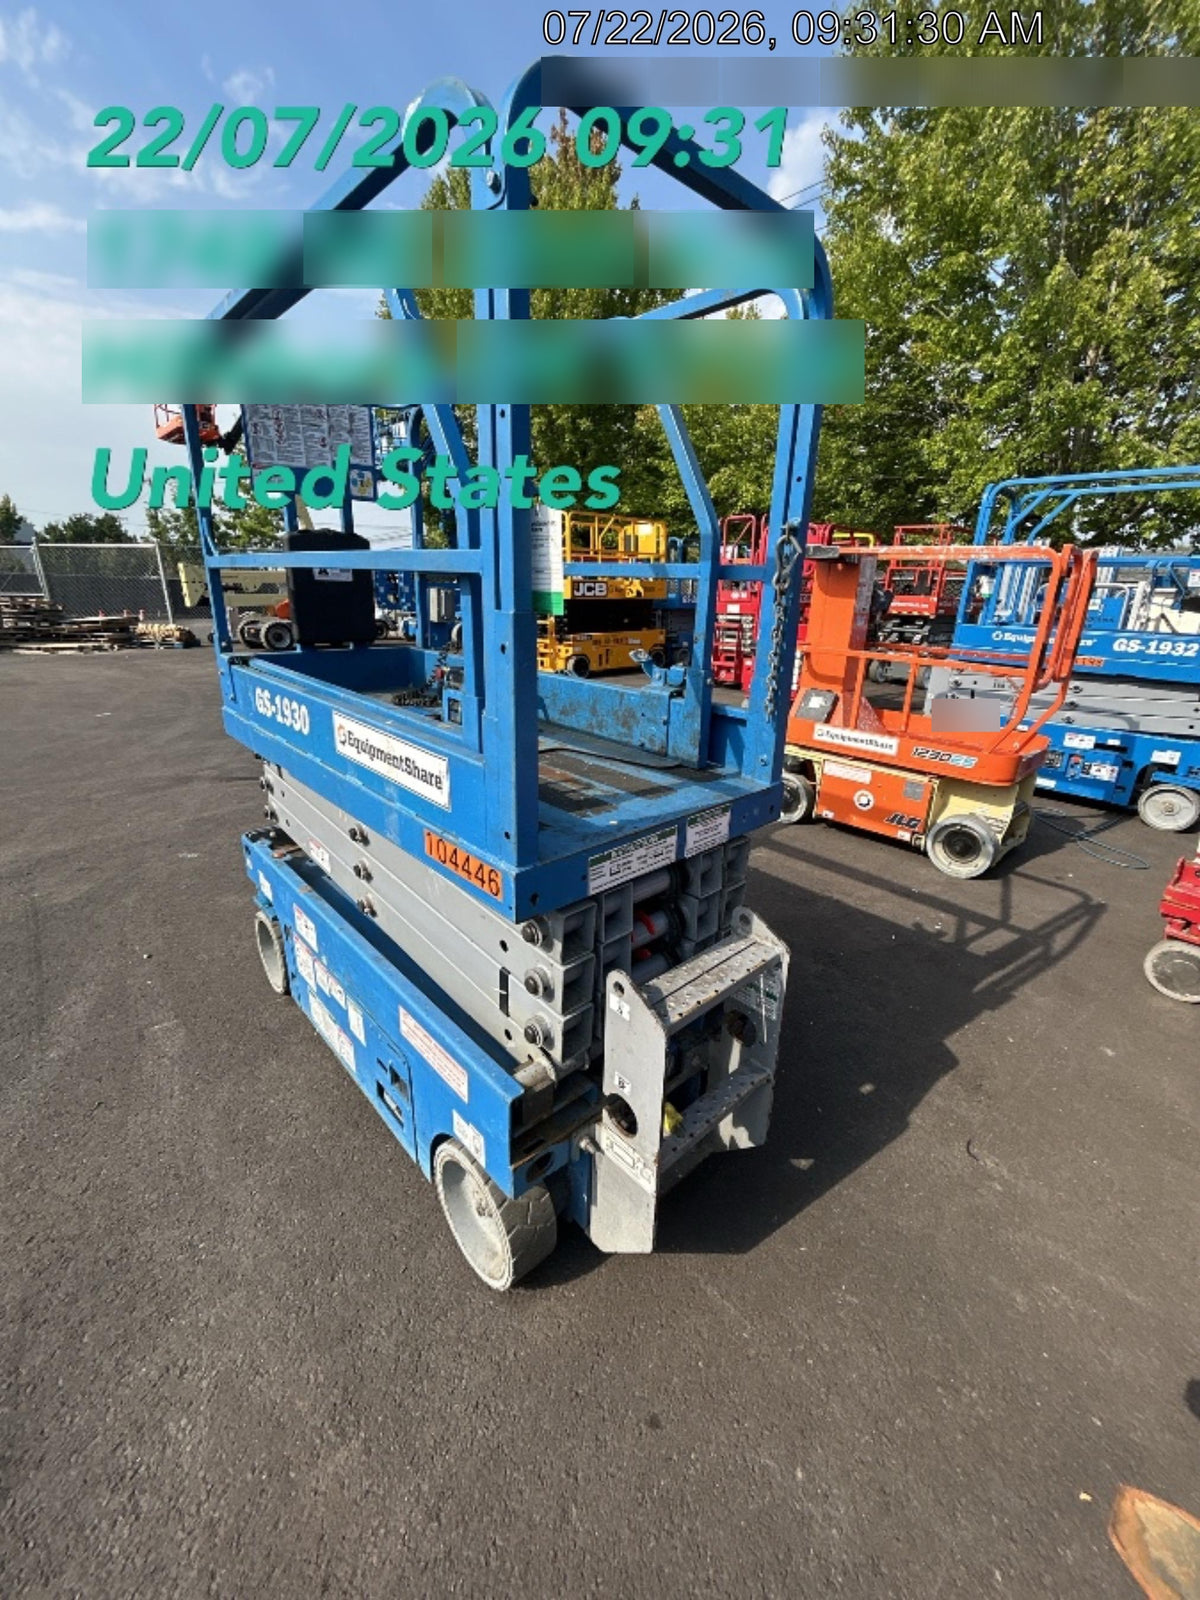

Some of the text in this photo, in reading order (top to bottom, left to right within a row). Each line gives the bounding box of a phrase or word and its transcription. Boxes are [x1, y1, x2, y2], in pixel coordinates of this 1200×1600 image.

[573, 582, 607, 597] JCB
[1112, 637, 1200, 658] GS-1932
[254, 686, 311, 736] GS-1930
[347, 729, 443, 790] EquipmentShare
[886, 812, 922, 828] JLG
[425, 831, 501, 897] 104446
